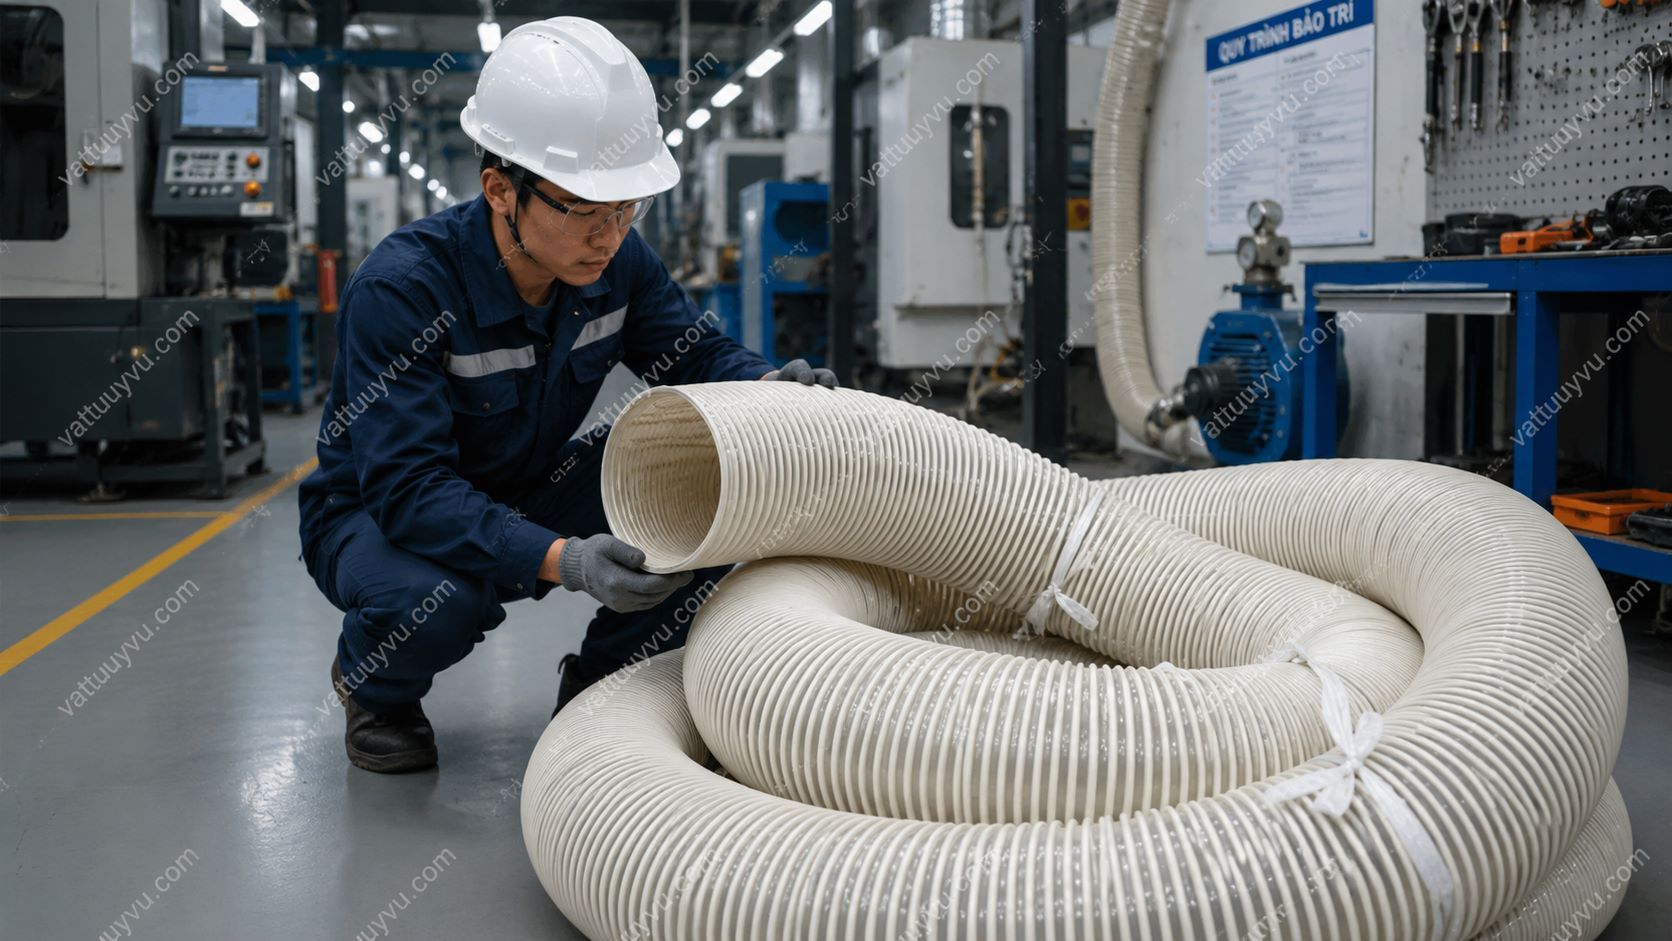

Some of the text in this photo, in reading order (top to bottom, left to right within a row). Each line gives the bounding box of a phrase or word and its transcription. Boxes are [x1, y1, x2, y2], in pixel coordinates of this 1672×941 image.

[1218, 35, 1246, 63] QUY
[1247, 23, 1290, 52] TRÌNH
[1292, 8, 1324, 38] BẢO
